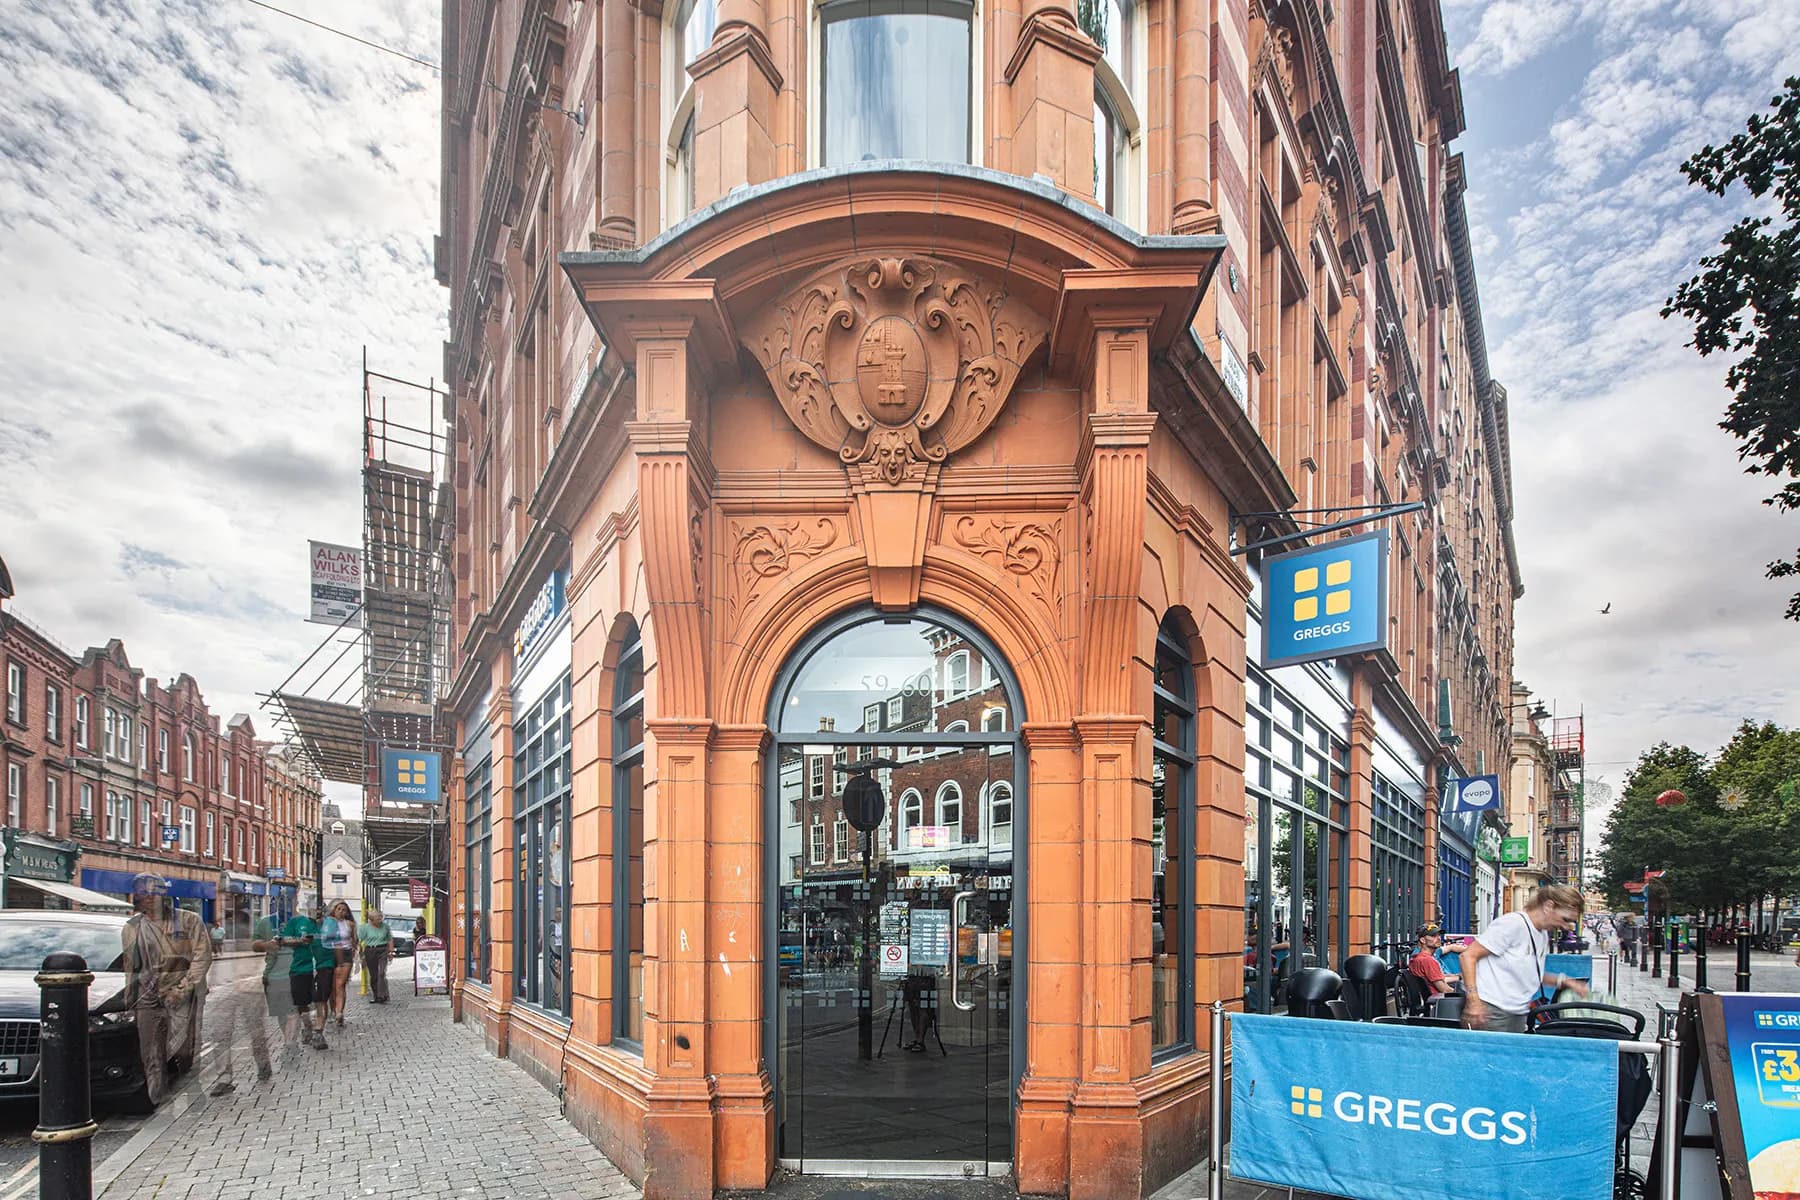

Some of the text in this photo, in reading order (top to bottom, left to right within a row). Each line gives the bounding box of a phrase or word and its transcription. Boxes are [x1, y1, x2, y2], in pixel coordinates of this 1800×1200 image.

[316, 548, 356, 564] ALAN
[313, 560, 360, 577] WILKS
[312, 570, 350, 583] SCAFFOLDING
[1293, 620, 1351, 641] GREGGS
[397, 786, 427, 794] GREGGS
[1463, 789, 1491, 798] evapo
[1775, 1014, 1800, 1027] GR
[1333, 1091, 1527, 1146] GREGGS
